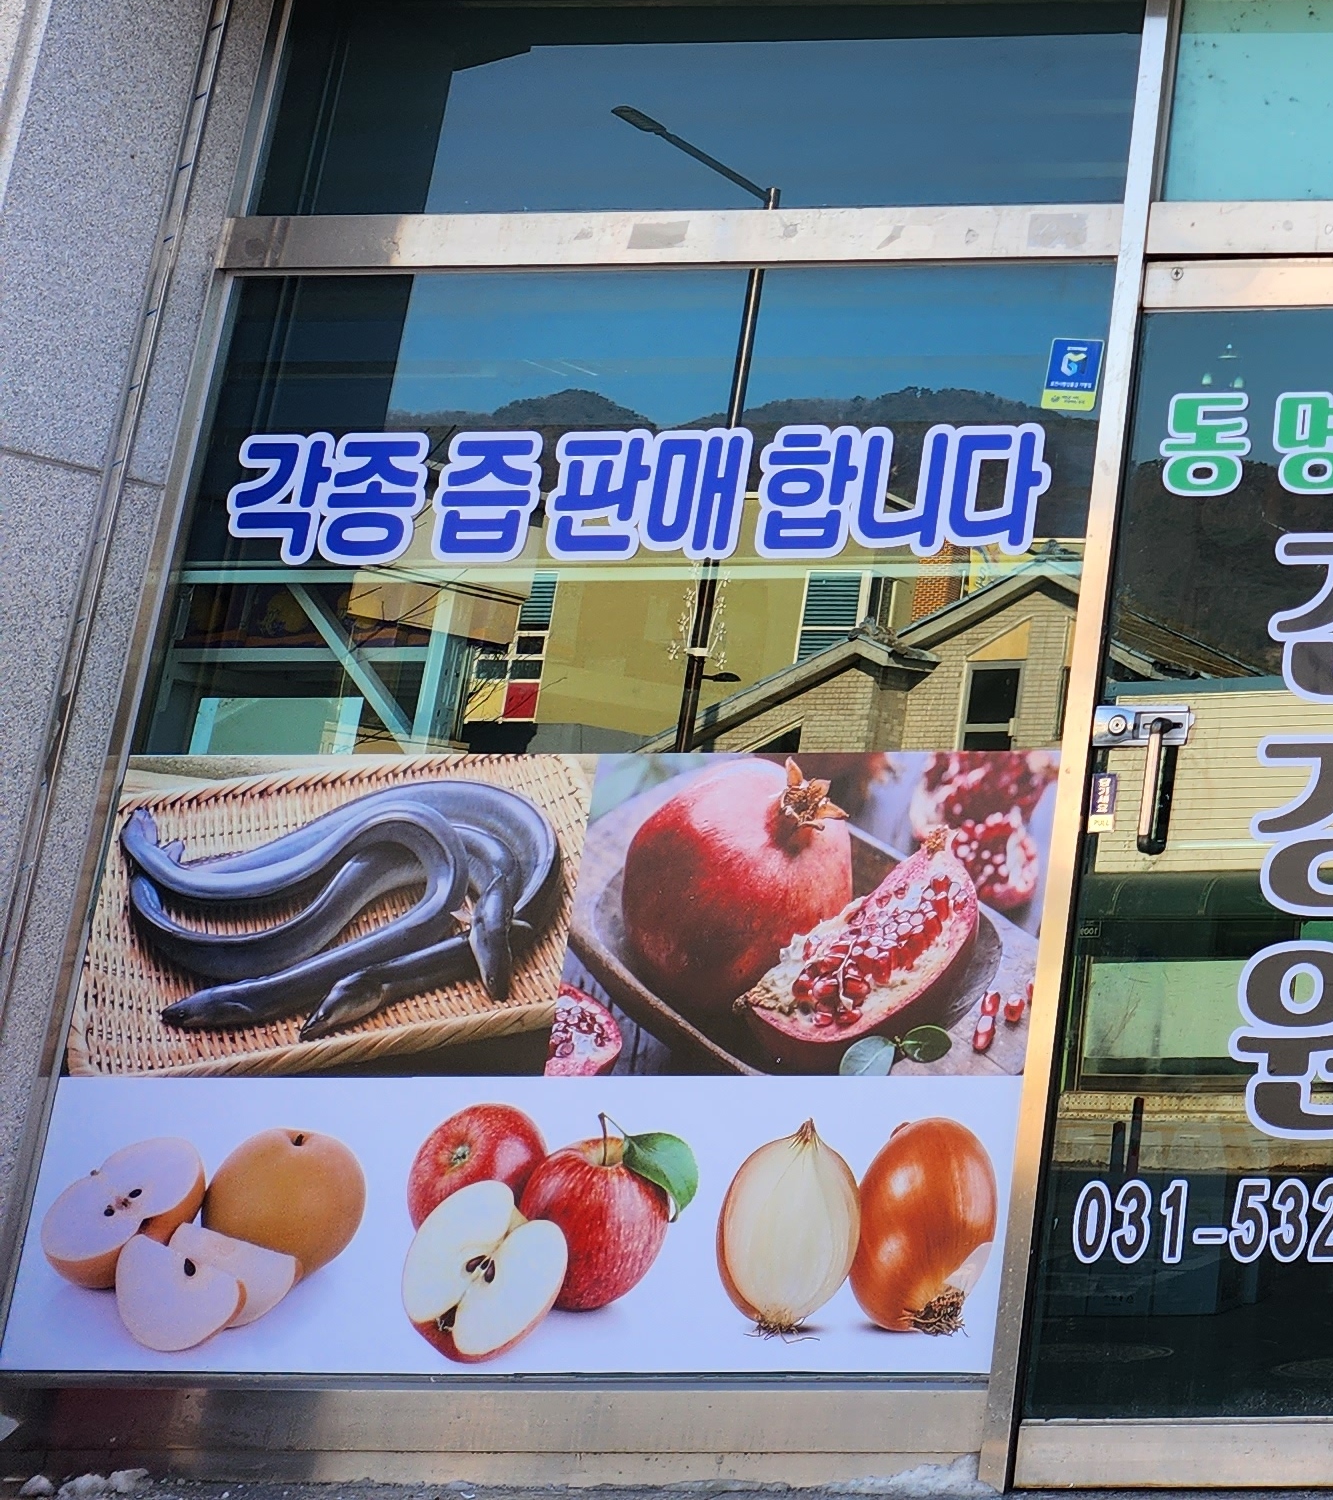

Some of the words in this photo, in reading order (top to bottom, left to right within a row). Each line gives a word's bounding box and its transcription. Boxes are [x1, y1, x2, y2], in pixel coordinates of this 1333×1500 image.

[227, 430, 430, 566] 각종
[431, 431, 542, 562] 즙
[545, 427, 753, 562] 판매
[755, 423, 1052, 561] 합니다
